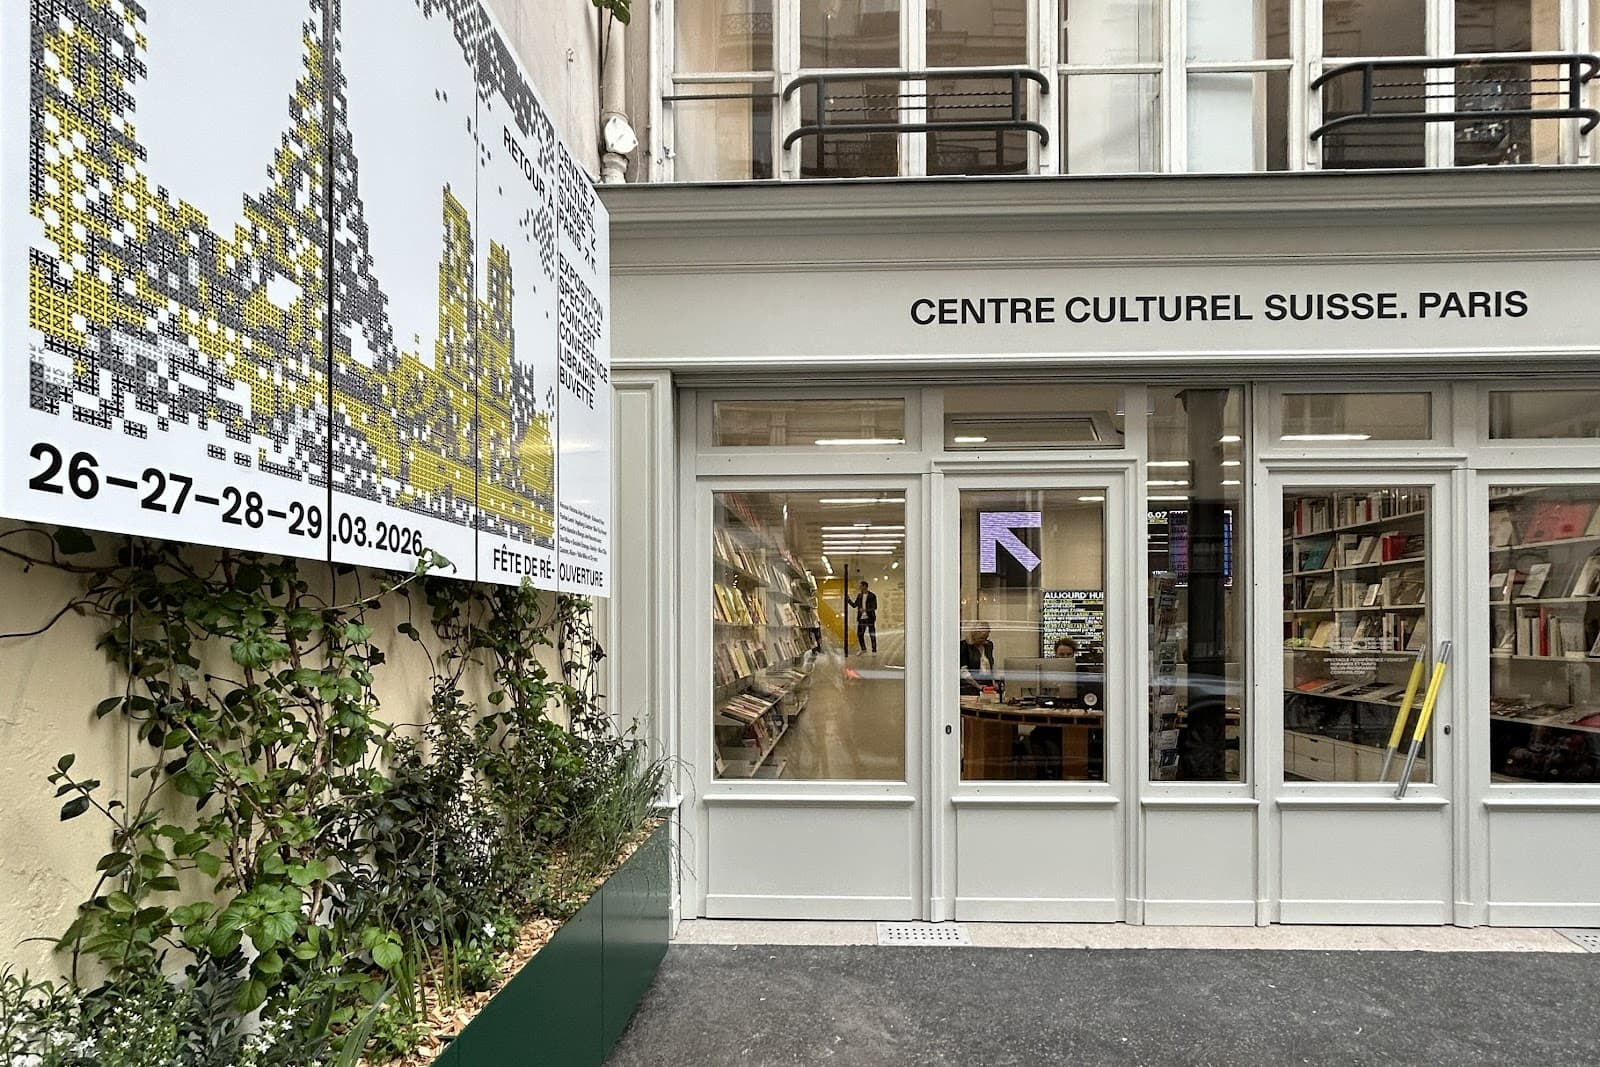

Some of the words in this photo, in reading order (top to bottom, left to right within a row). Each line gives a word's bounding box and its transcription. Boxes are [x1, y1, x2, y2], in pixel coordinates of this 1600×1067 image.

[503, 125, 545, 203] RETOUR
[548, 187, 555, 216] À
[558, 141, 588, 200] CENTRE
[558, 164, 596, 233] CULTUREL
[558, 185, 586, 238] SUISSE
[559, 208, 582, 252] PARIS
[559, 252, 603, 321] EXPOSITION
[559, 275, 602, 338] SPECTACLE
[910, 298, 1055, 326] CENTRE
[1065, 294, 1253, 323] CULTUREL
[1264, 292, 1407, 322] SUISSE.
[1419, 289, 1529, 319] PARIS
[559, 299, 596, 350] CONCERT
[559, 342, 596, 391] LIBRAIRIE
[559, 365, 594, 410] BUVETTE
[493, 543, 522, 575] FÊTE
[524, 555, 538, 577] DE
